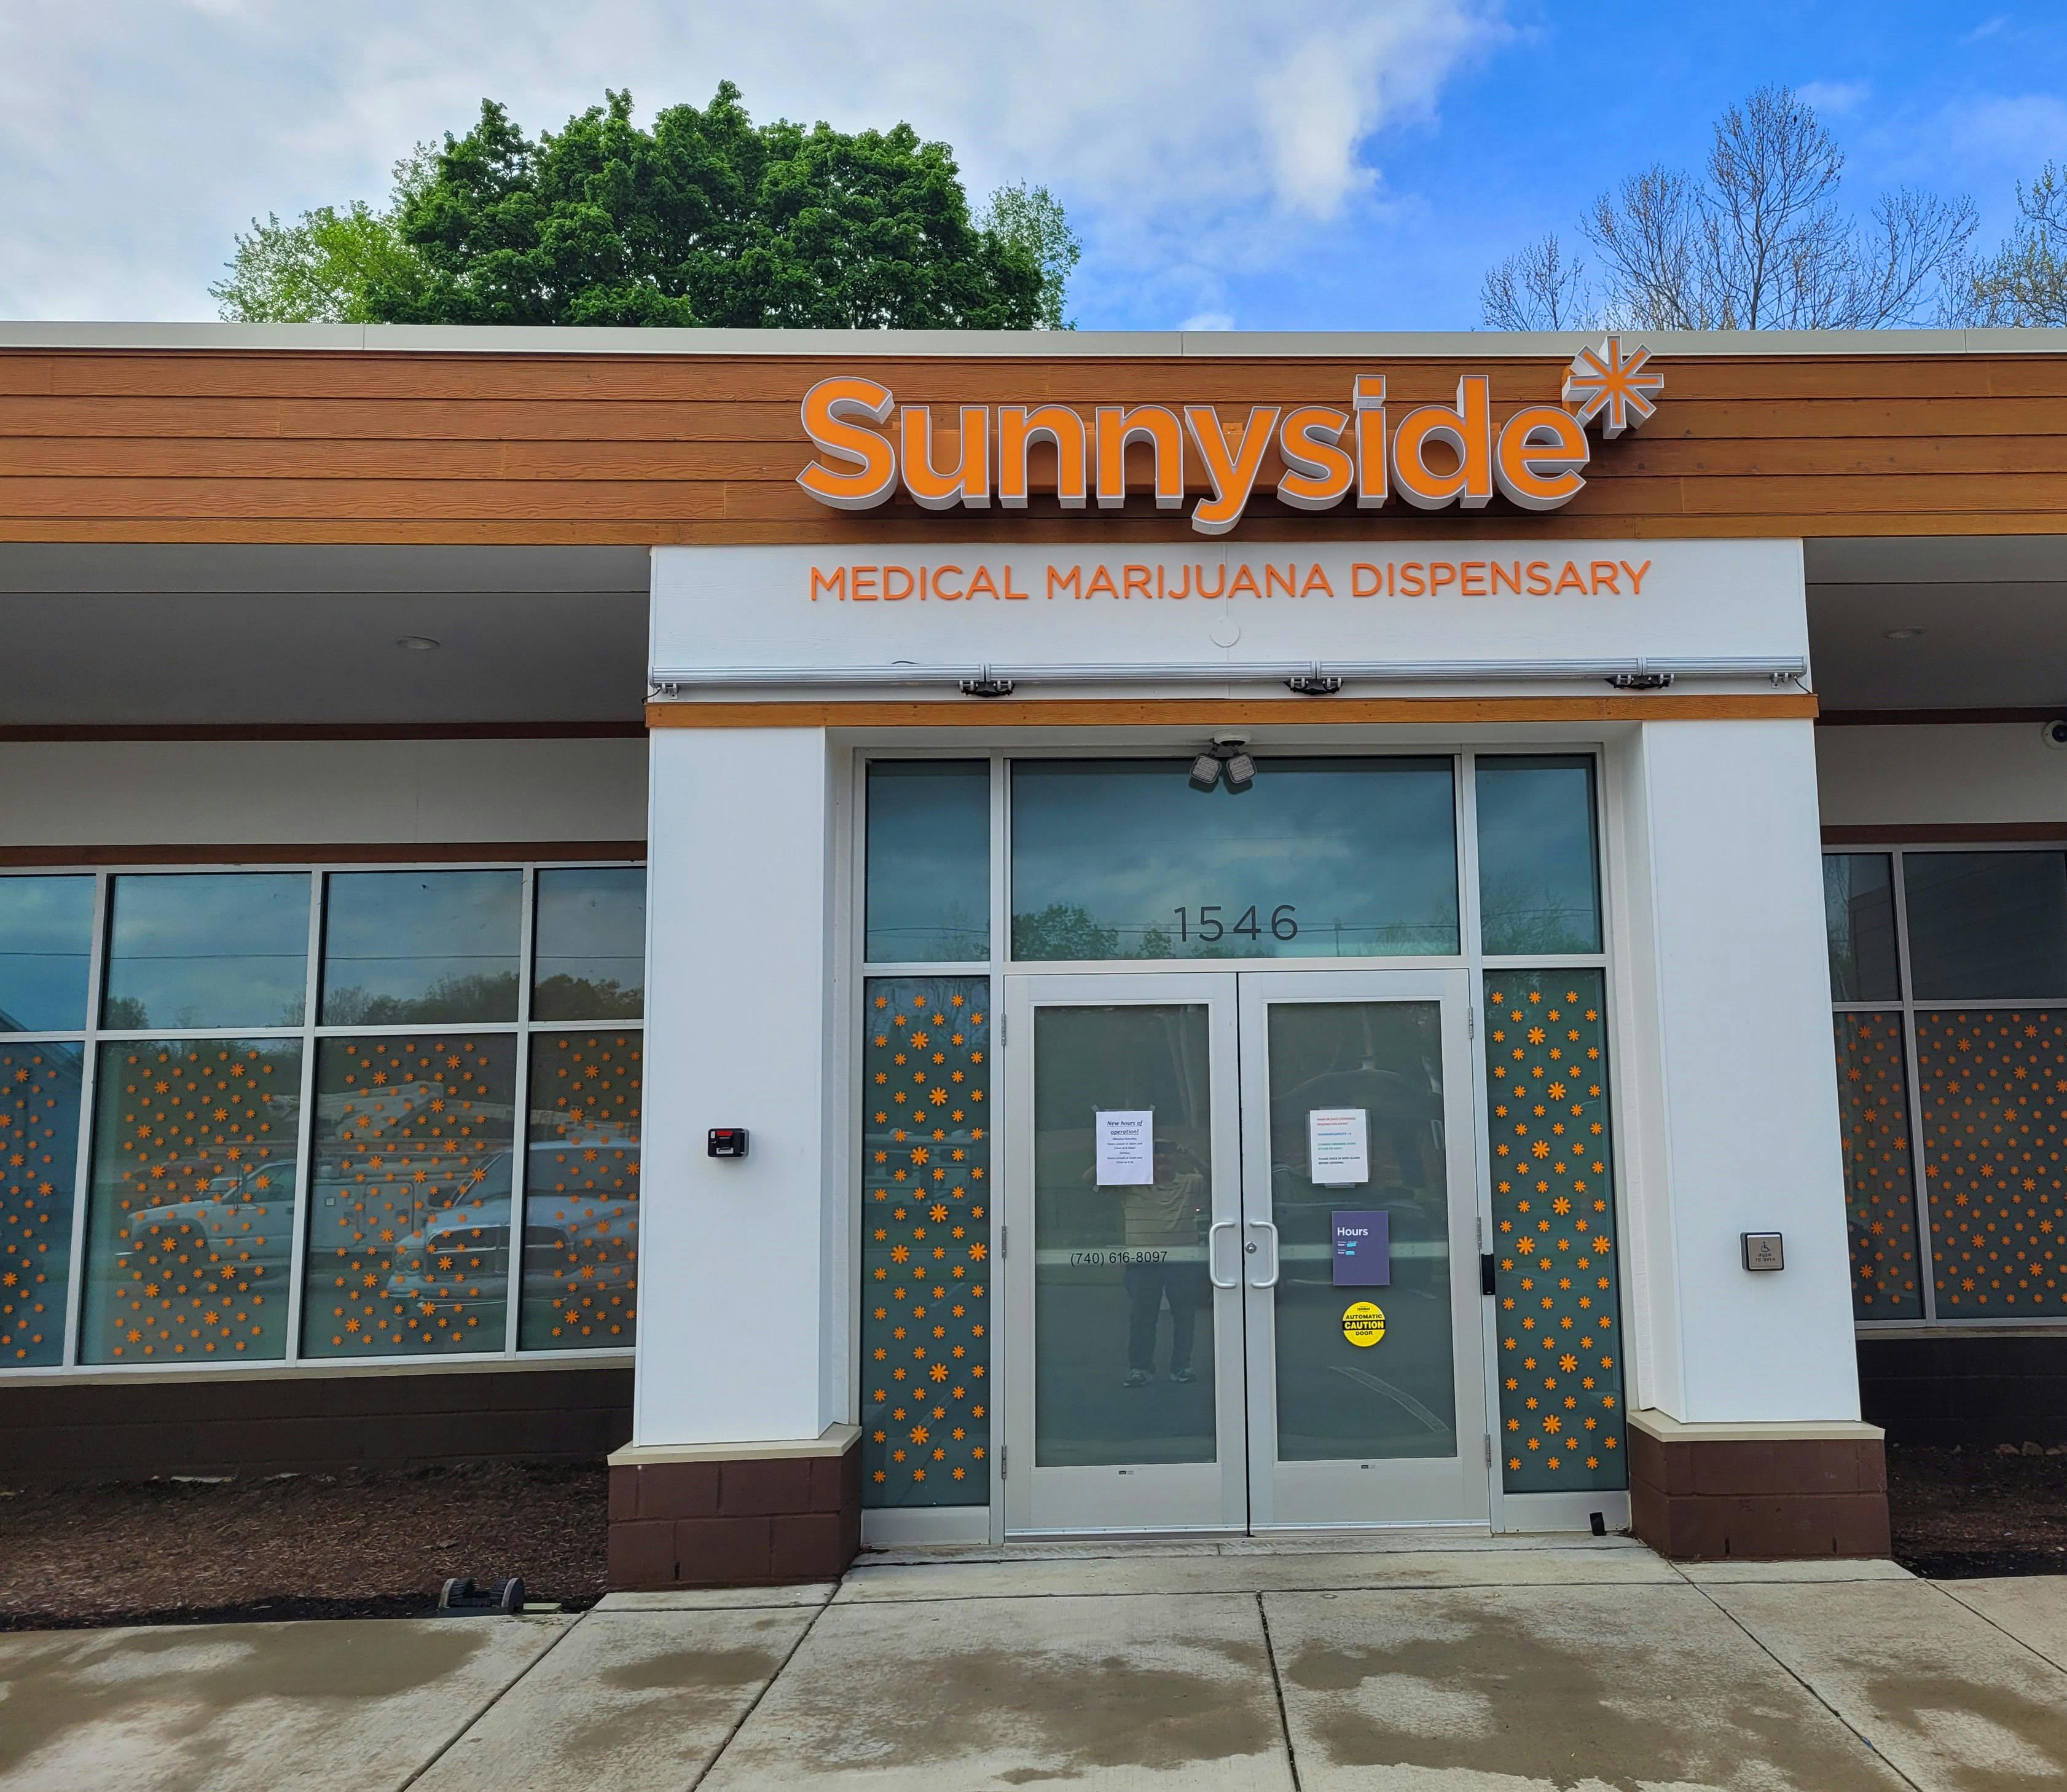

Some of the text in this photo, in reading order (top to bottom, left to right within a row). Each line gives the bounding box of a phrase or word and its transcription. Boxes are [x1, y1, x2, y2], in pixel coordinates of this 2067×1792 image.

[796, 374, 1590, 535] Sunnyside
[810, 560, 1652, 600] MEDICAL MARIJUANA DISPENSARY
[1174, 905, 1298, 942] 1546
[1337, 1227, 1368, 1236] Hours
[1070, 1251, 1168, 1267] (740) 616-8097
[1344, 1321, 1384, 1329] CAUTION
